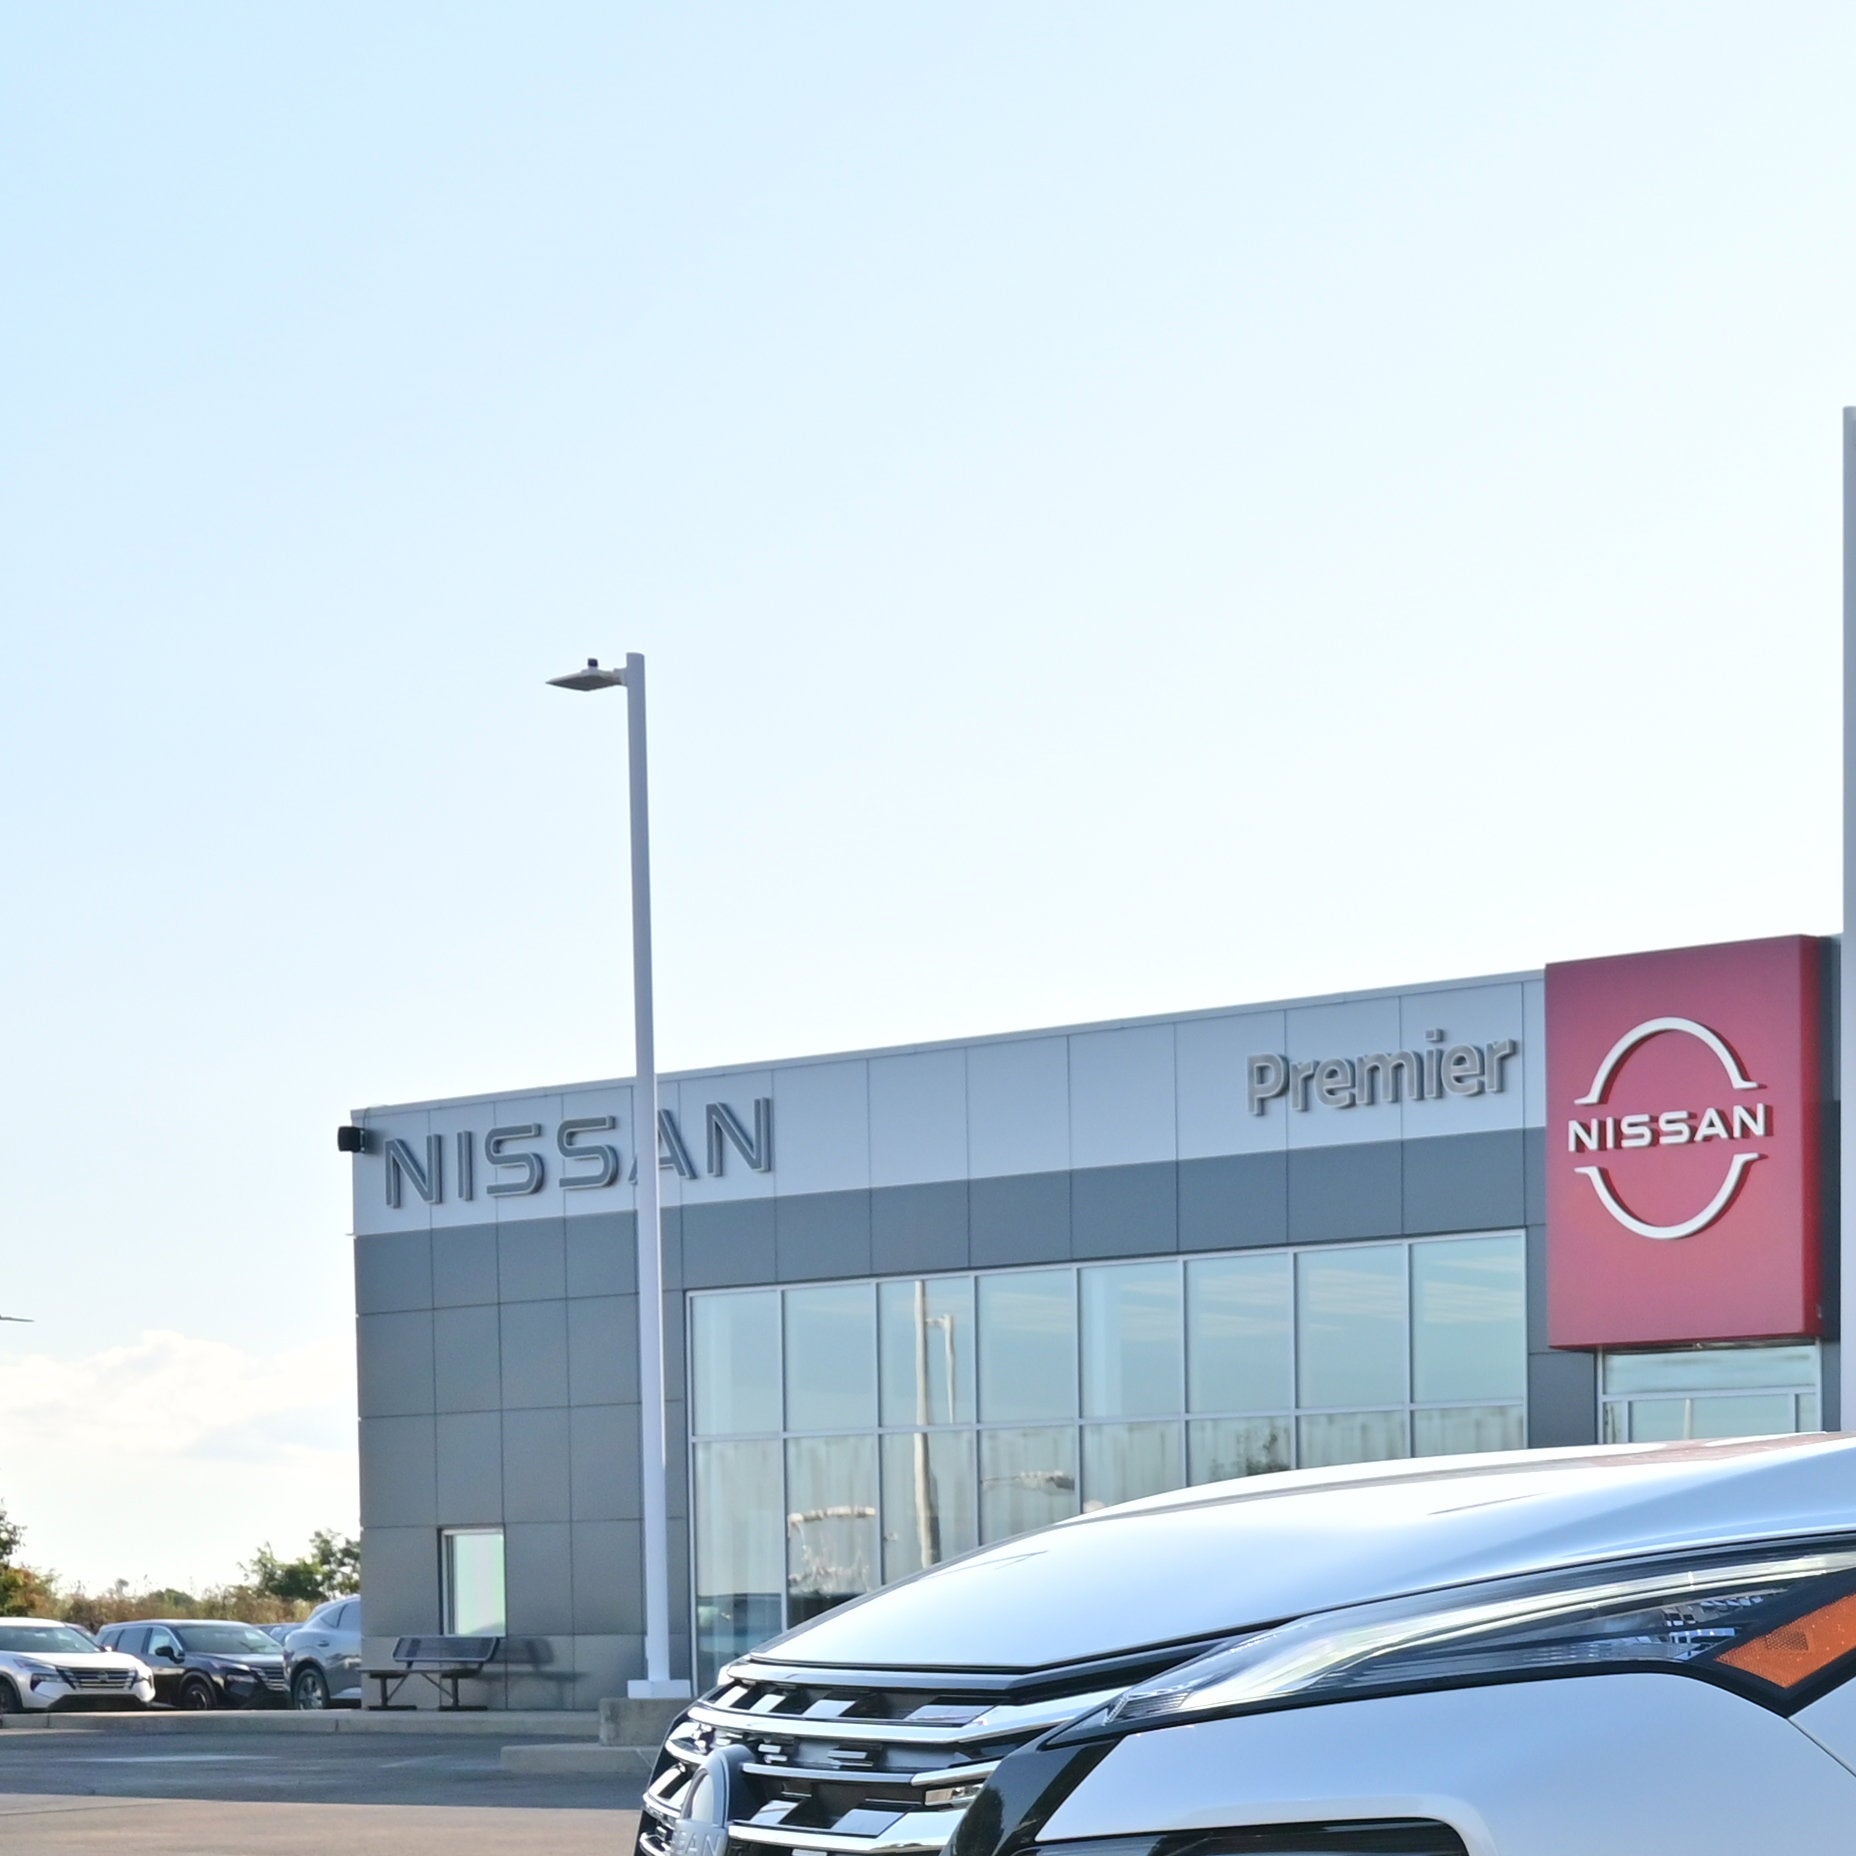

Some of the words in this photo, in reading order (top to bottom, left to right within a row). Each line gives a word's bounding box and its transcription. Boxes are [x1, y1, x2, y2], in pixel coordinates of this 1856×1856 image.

[1247, 1028, 1516, 1116] Premier
[384, 1097, 770, 1208] NISSAN
[1568, 1103, 1770, 1152] NISSAN
